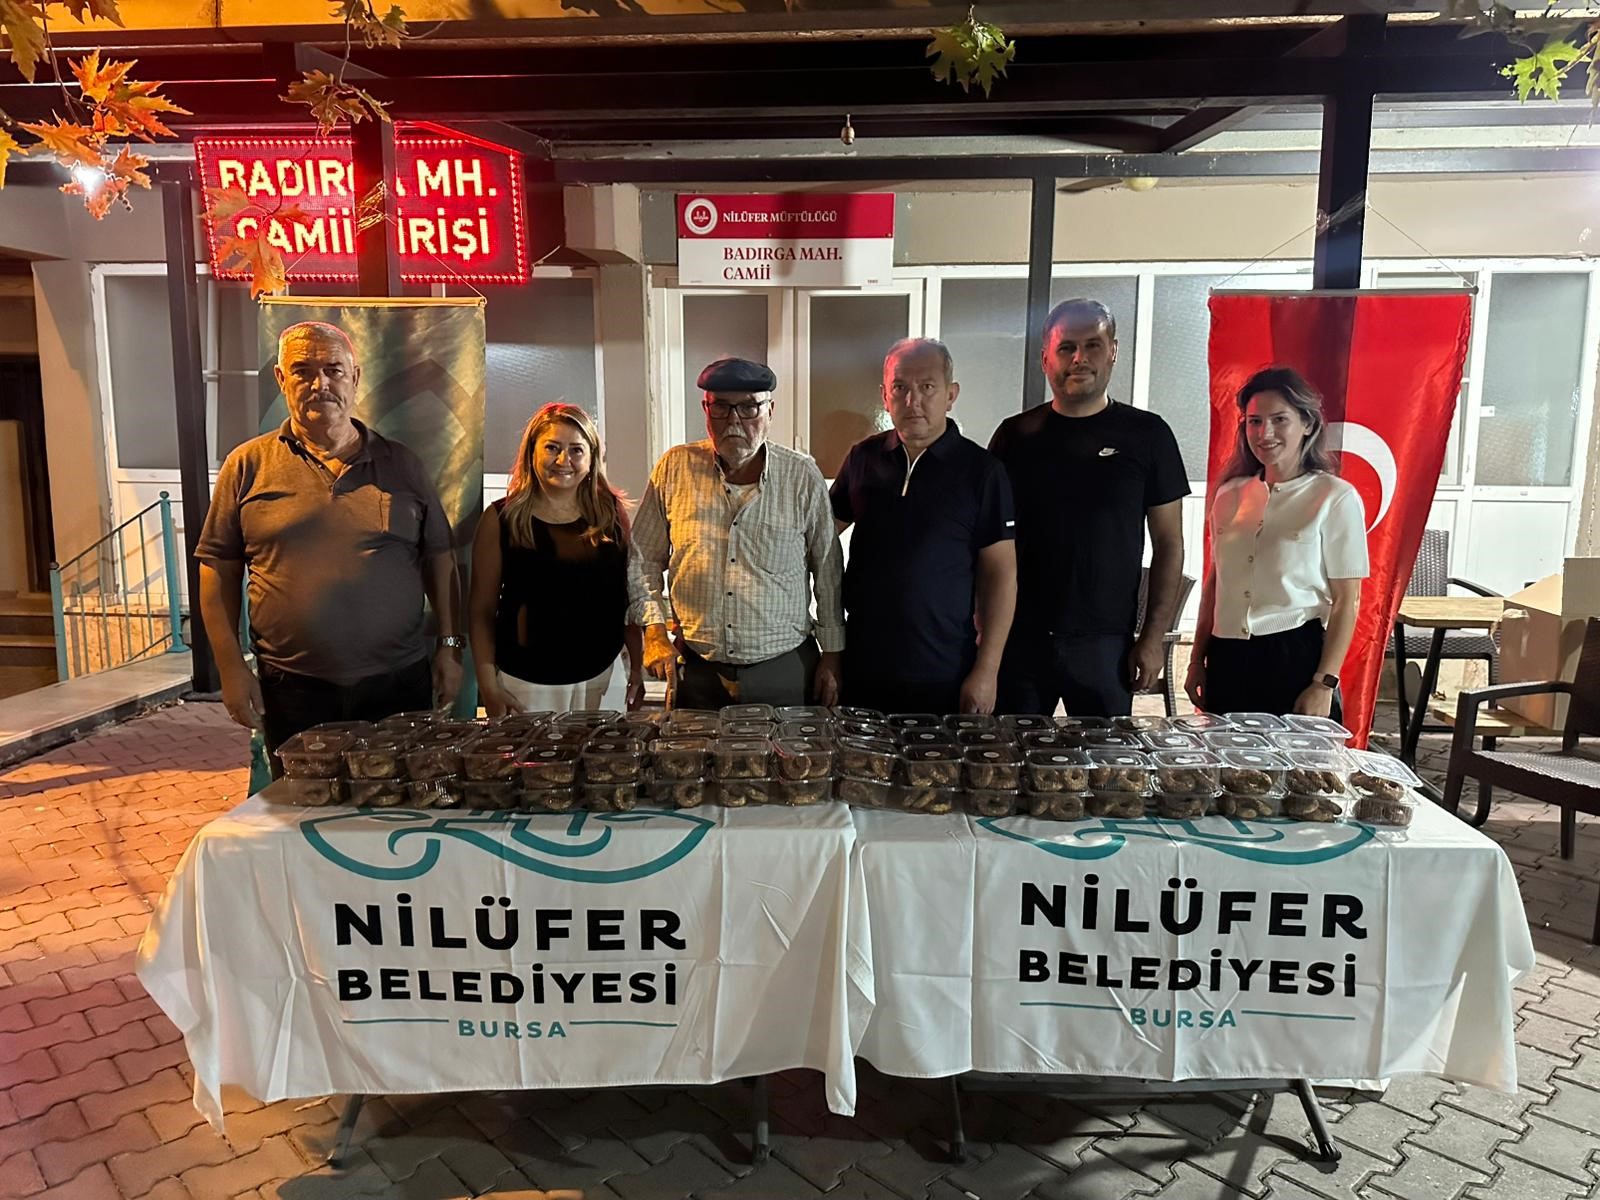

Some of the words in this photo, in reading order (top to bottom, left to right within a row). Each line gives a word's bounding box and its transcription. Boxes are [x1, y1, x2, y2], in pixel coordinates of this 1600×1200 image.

[416, 159, 497, 197] MH.
[397, 207, 491, 260] İRİŞİ
[723, 211, 769, 222] NİLÜFER
[769, 210, 837, 223] MÜFTÜLÜĞÜ
[723, 246, 796, 261] BADIRGA
[799, 246, 843, 261] MAH.
[723, 264, 771, 280] CAMİİ
[334, 893, 686, 951] NİLÜFER
[1020, 873, 1368, 940] NİLÜFER
[337, 963, 677, 1005] BELEDİYESİ
[1018, 948, 1356, 997] BELEDİYESİ
[458, 1019, 566, 1039] BURSA
[1130, 1008, 1236, 1028] BURSA
